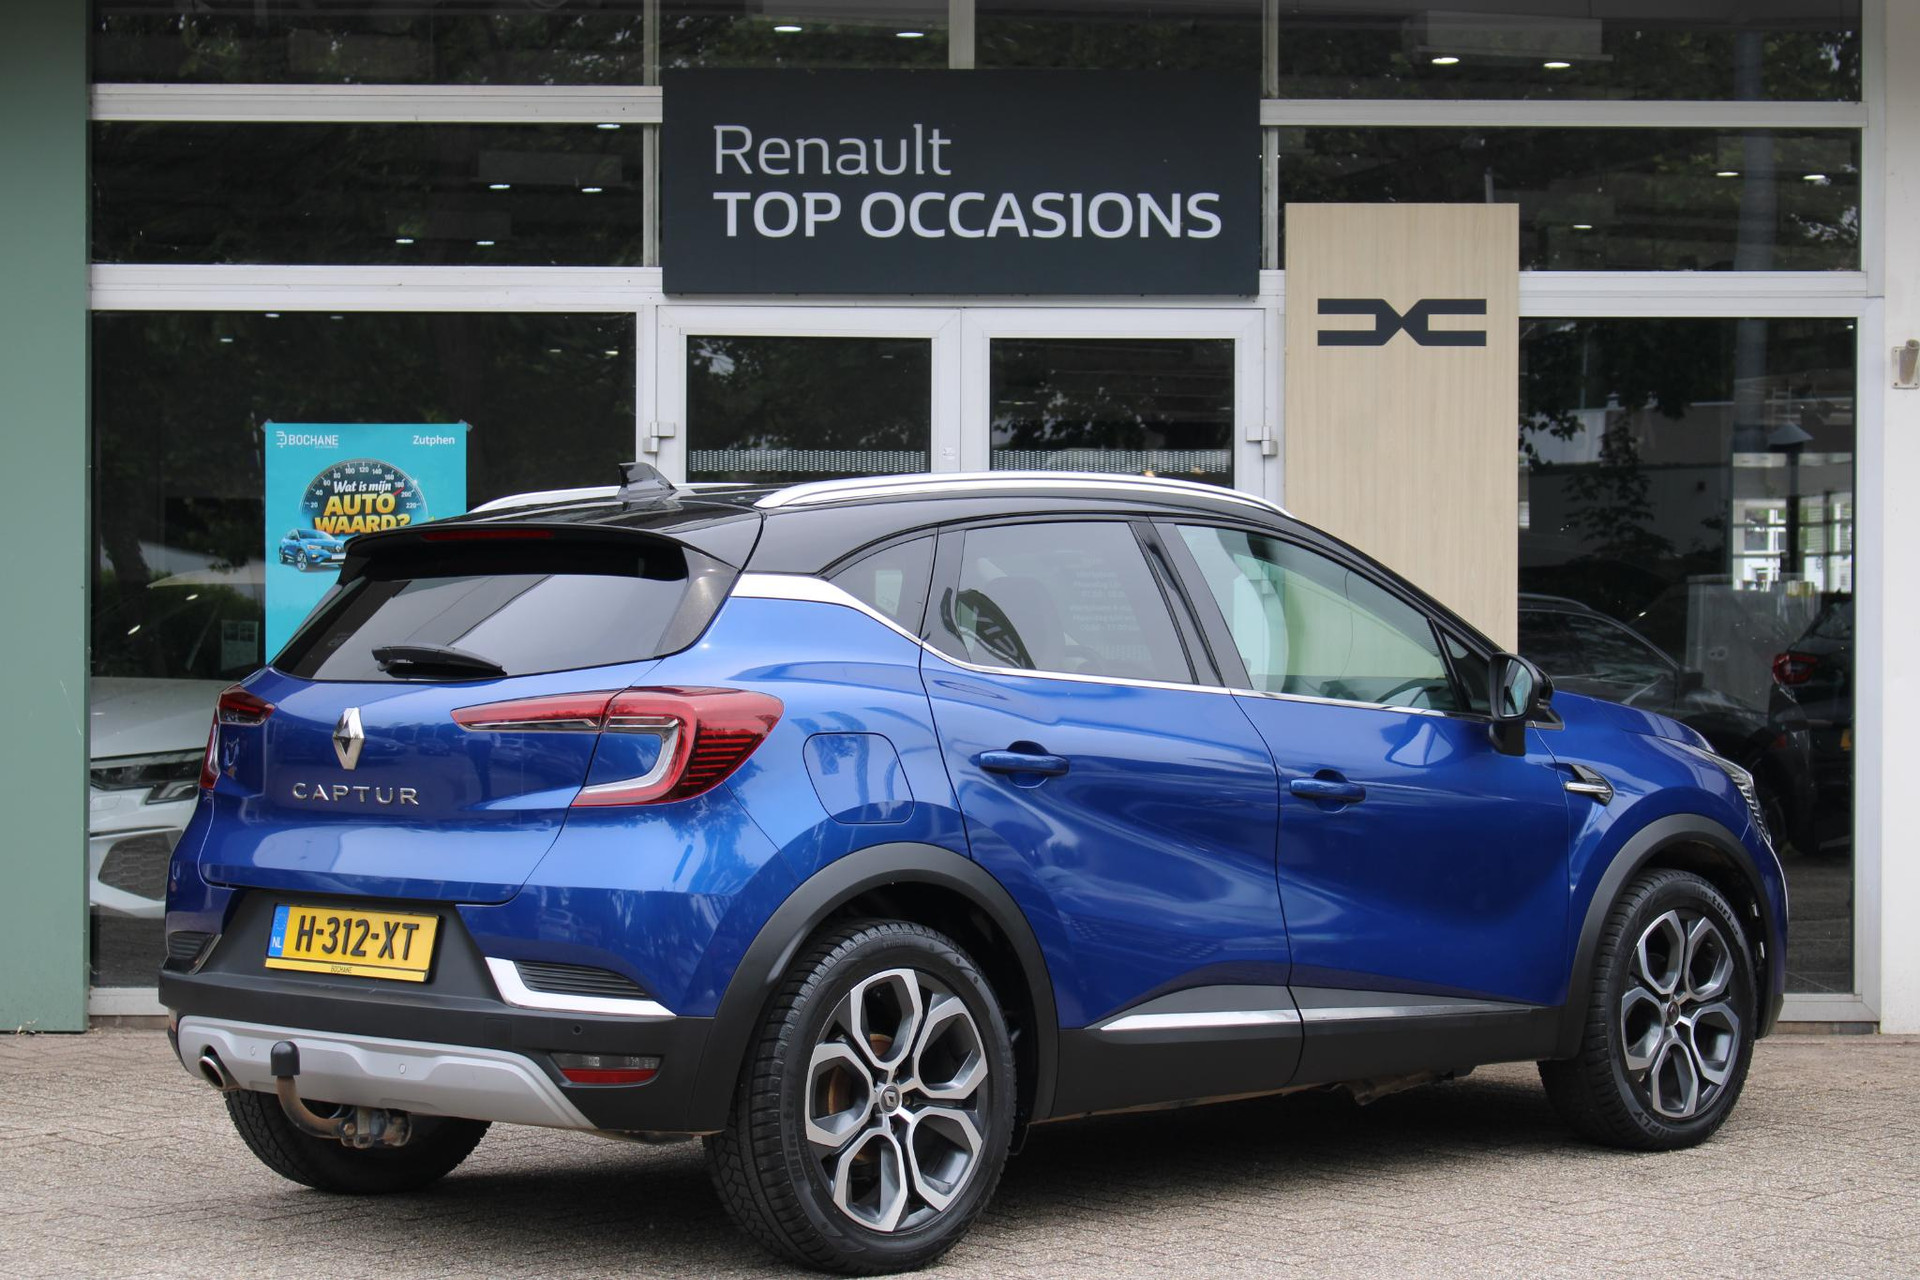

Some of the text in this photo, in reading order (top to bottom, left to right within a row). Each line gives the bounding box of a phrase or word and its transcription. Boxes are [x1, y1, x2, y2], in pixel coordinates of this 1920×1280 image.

[713, 123, 952, 176] Renault
[712, 191, 1223, 239] TOP OCCASIONS
[288, 434, 339, 446] BOCHANE
[412, 435, 456, 448] Zutphen
[333, 480, 392, 494] Wat is mijn
[323, 493, 396, 516] AUTO
[314, 513, 411, 534] WAARD?
[292, 782, 420, 805] CAPTUR
[272, 936, 282, 949] NL
[295, 914, 420, 961] H-312-XT
